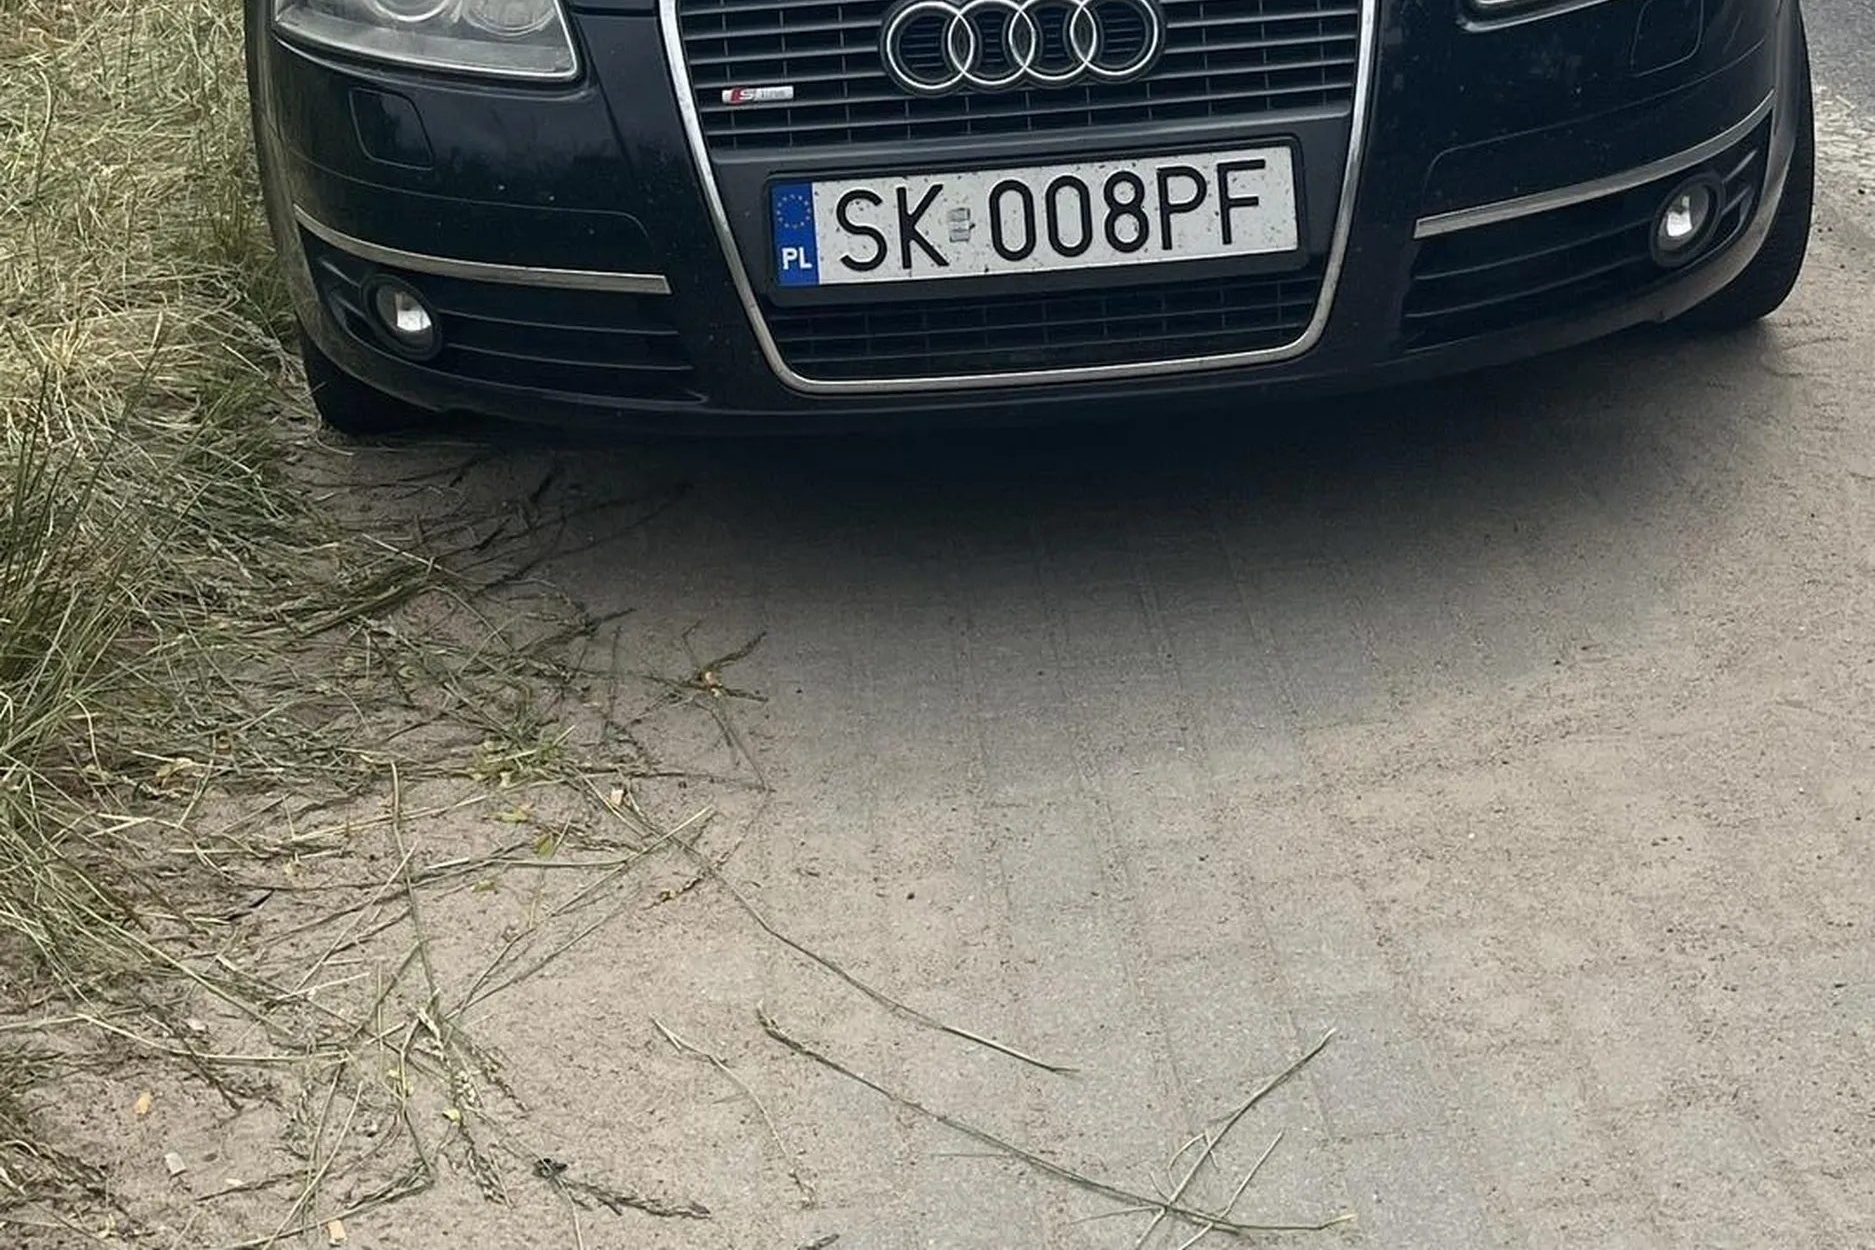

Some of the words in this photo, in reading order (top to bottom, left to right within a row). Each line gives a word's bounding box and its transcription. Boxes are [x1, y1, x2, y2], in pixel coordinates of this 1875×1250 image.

[835, 183, 950, 272] SK
[988, 158, 1266, 262] 008PF
[781, 248, 812, 271] PL
